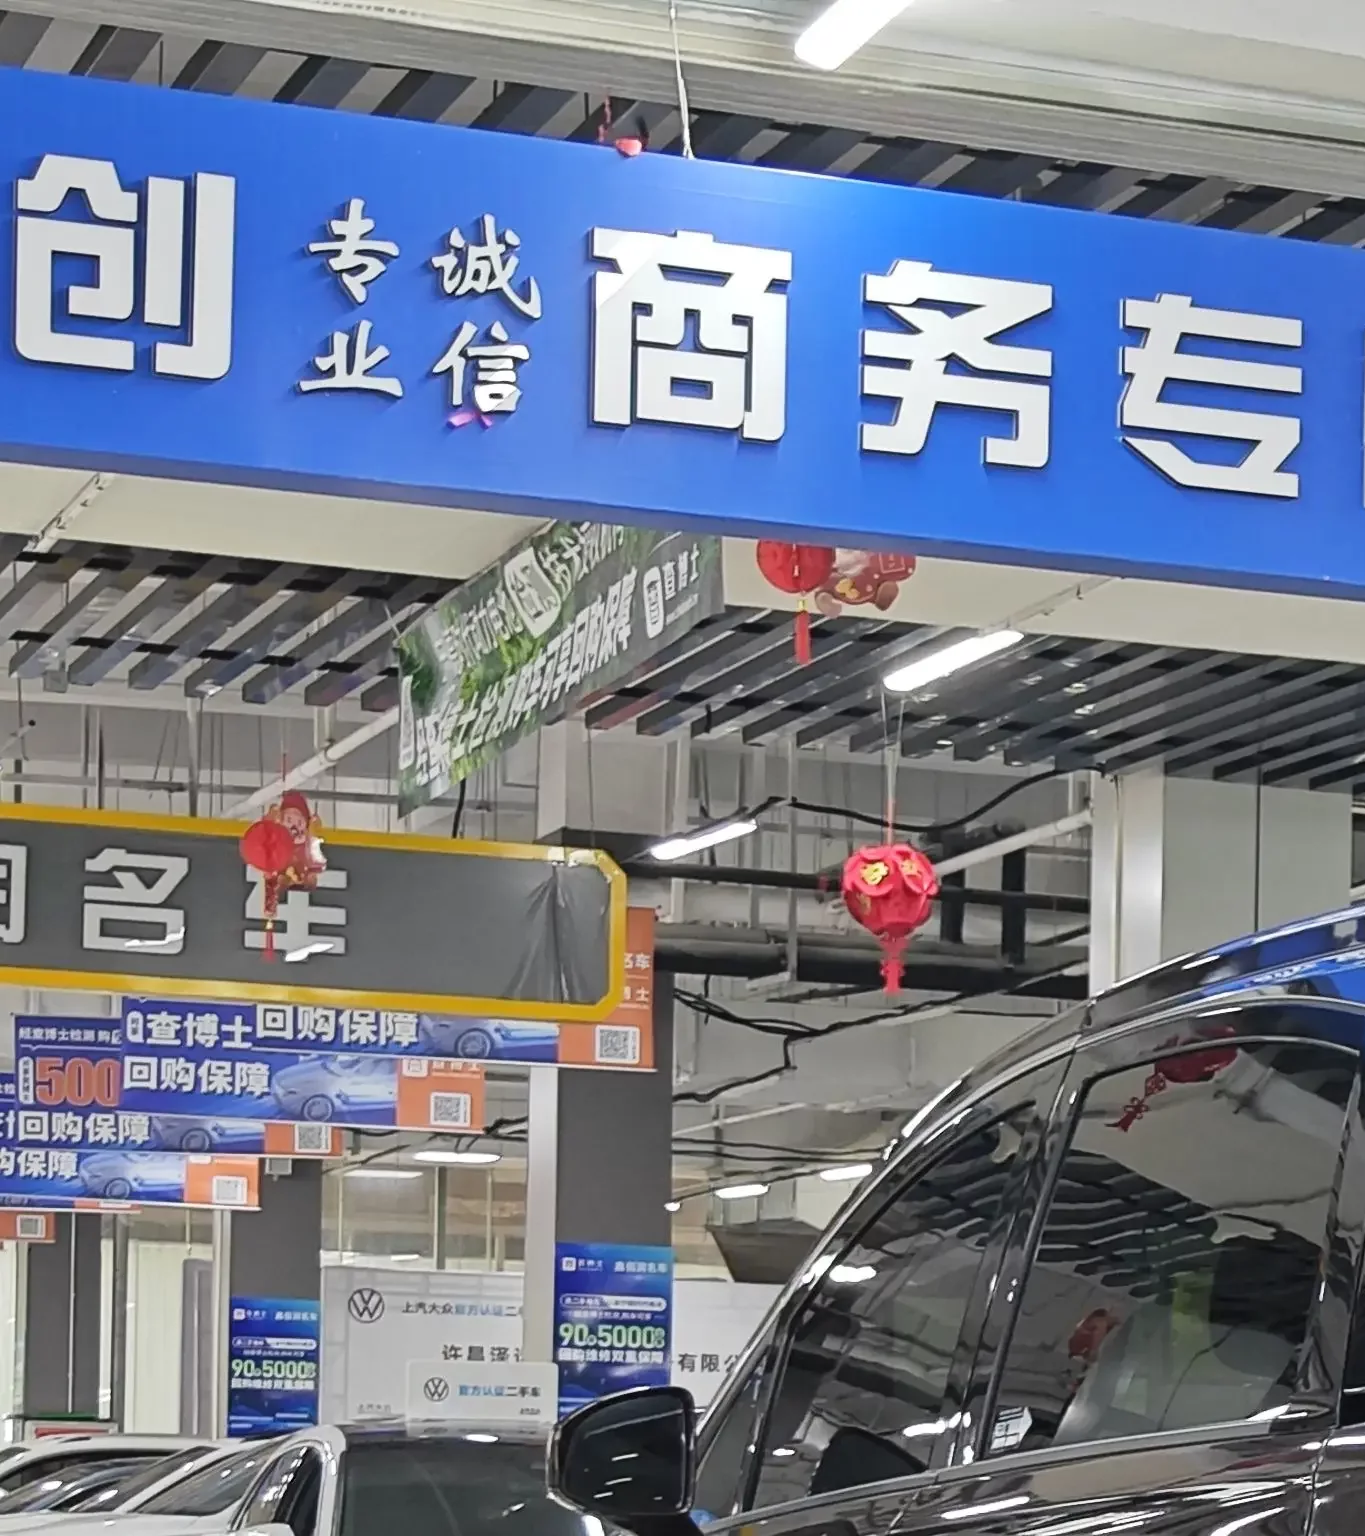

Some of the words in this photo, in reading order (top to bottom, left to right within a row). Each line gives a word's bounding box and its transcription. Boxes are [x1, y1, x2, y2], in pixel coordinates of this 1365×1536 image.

[15, 153, 236, 379] 创
[0, 842, 349, 962] 名车
[256, 1004, 419, 1047] 回购保障
[35, 1056, 122, 1107] 500
[123, 1055, 270, 1098] 回购保障
[18, 1109, 151, 1145] 回购保障
[402, 1301, 523, 1317] 上汽大众官方认证二
